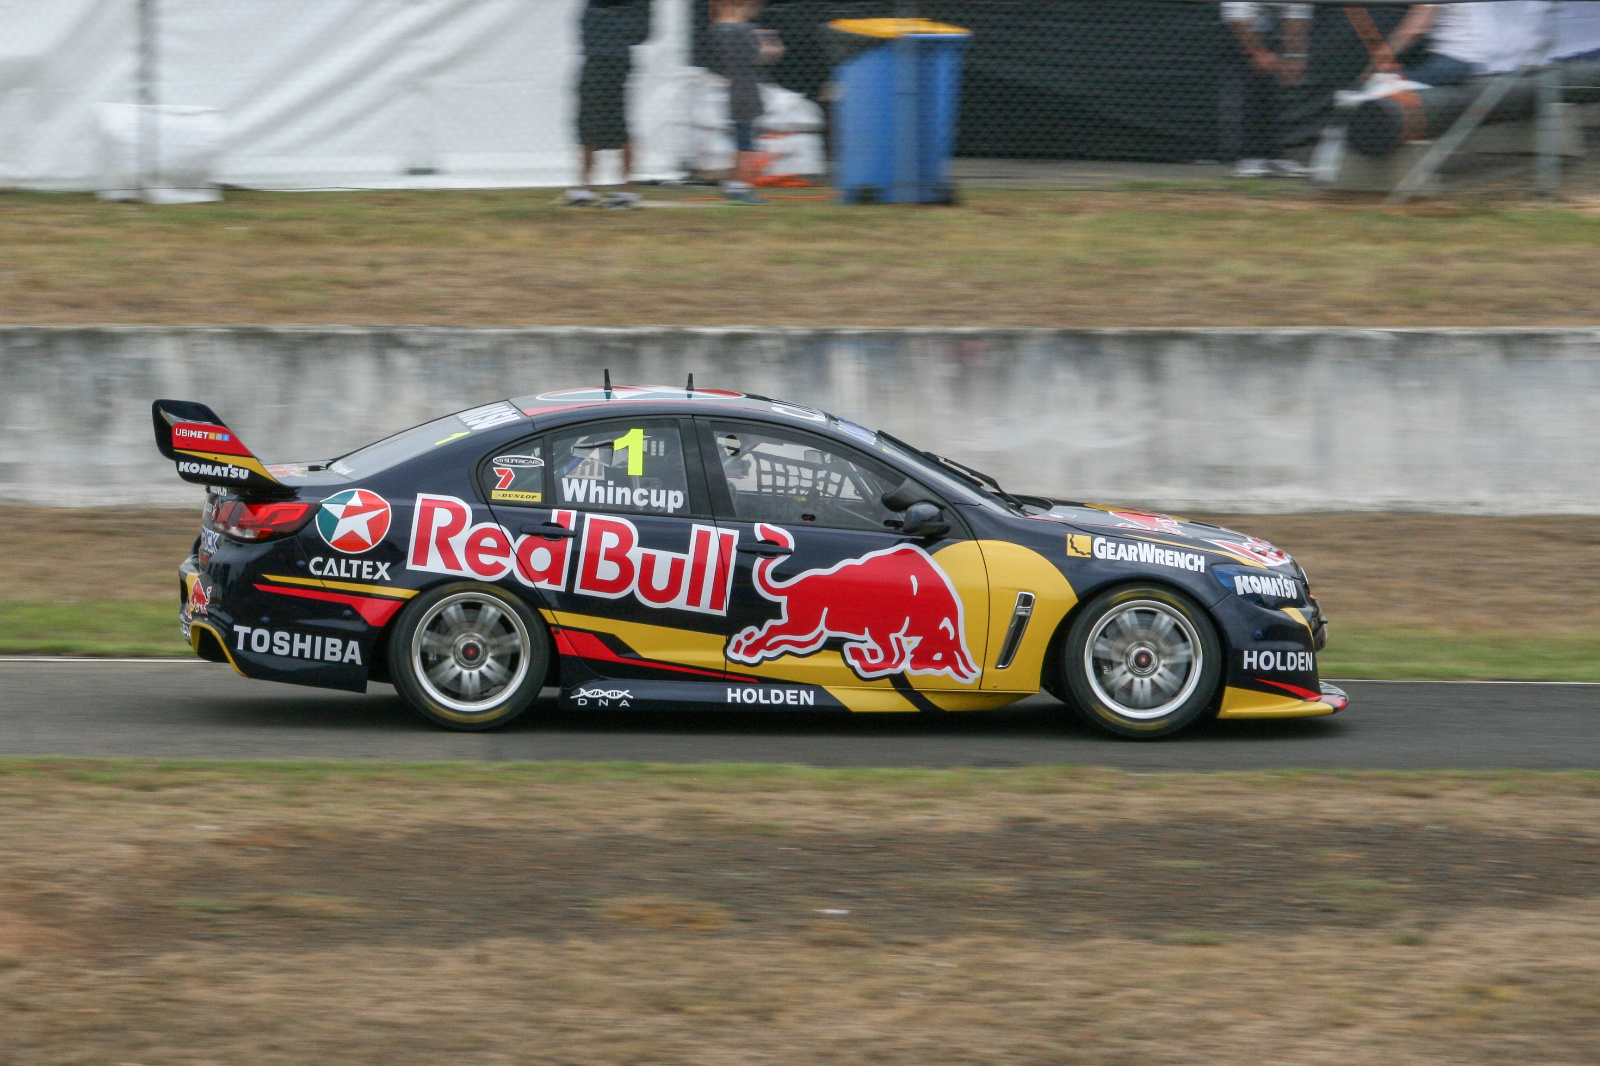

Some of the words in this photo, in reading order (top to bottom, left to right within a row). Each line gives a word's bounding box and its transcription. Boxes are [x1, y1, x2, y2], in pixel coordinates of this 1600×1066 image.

[175, 428, 208, 439] UBIMET
[613, 428, 643, 476] 1
[178, 461, 249, 479] KOMATSU
[493, 467, 515, 489] 7
[562, 478, 684, 513] Whincup
[406, 493, 577, 591] Red
[574, 513, 739, 616] Bull
[309, 556, 391, 581] CALTEX
[1234, 574, 1297, 600] KOMATSU
[233, 624, 362, 666] TOSHIBA
[1243, 650, 1312, 672] HOLDEN
[726, 687, 815, 706] HOLDEN
